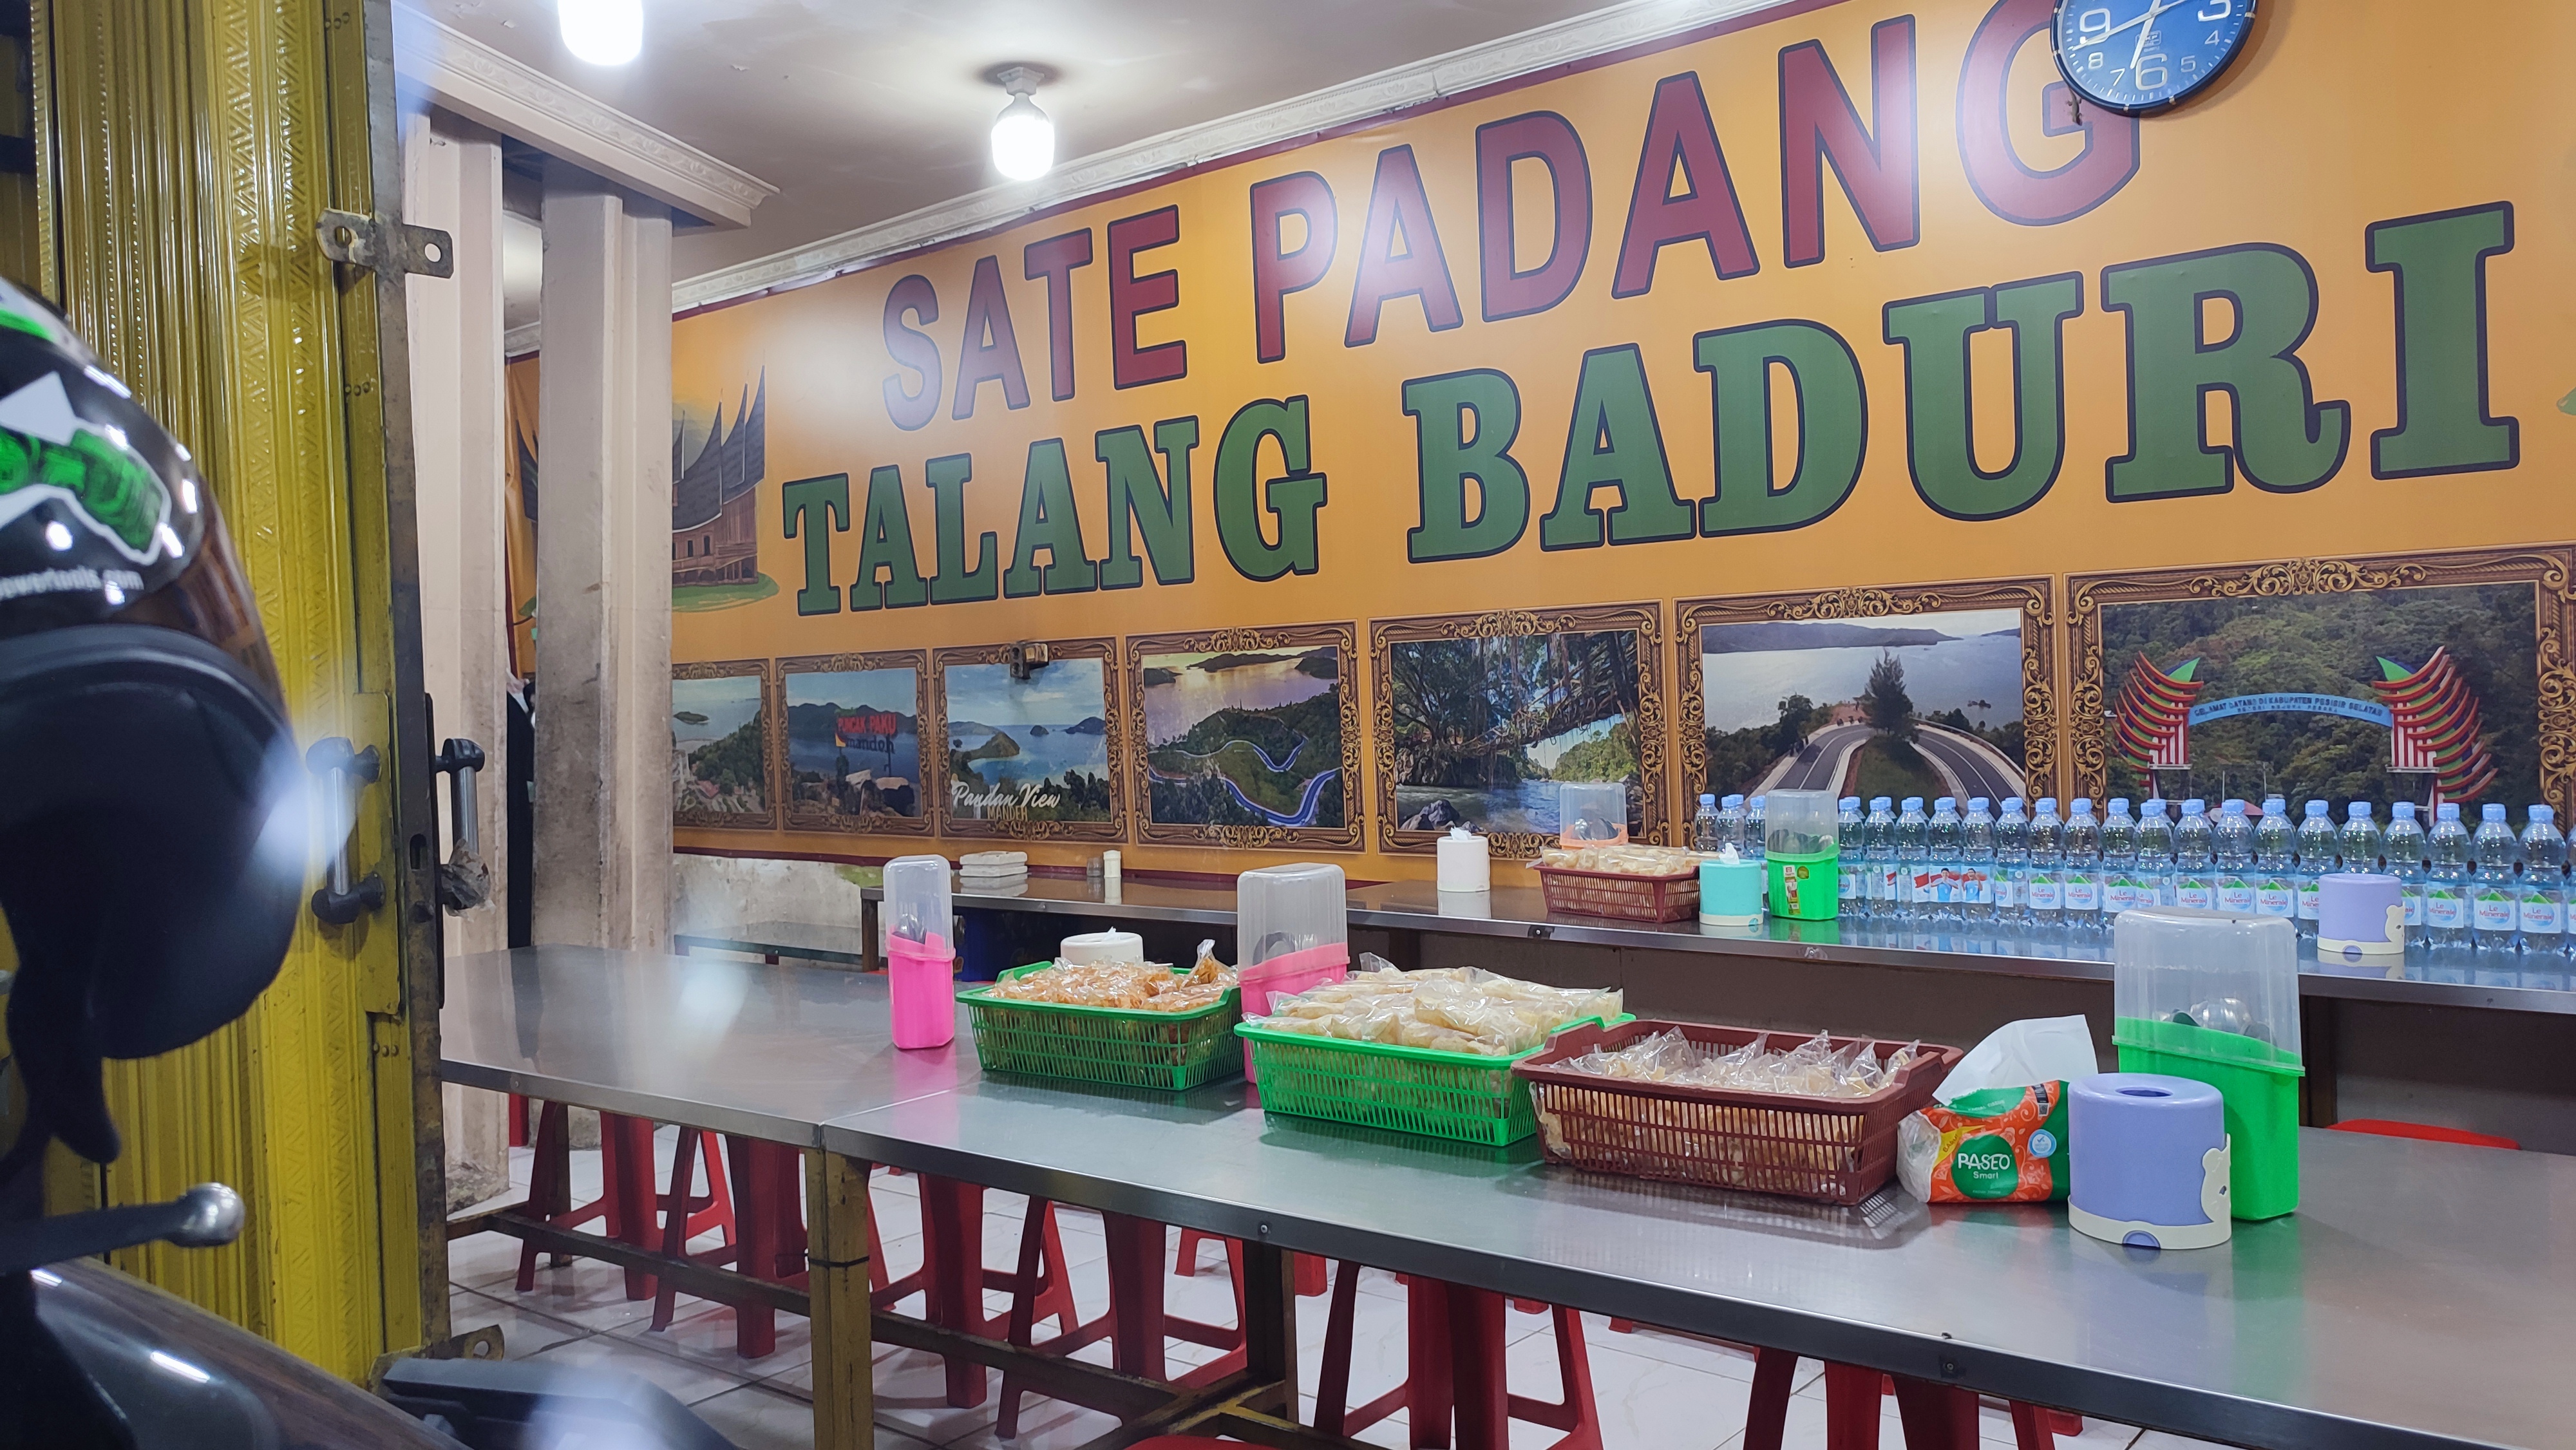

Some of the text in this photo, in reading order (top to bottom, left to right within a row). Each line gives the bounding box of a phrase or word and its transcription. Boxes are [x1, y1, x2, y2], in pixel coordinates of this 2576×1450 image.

[2079, 8, 2110, 43] 9
[2204, 30, 2220, 46] 4
[2088, 52, 2103, 70] 8
[2181, 55, 2196, 73] 5
[2109, 68, 2125, 86] 7
[2136, 53, 2168, 91] 6
[882, 0, 2141, 431] SATE PADANG
[782, 200, 2520, 616] TALANG BADURI
[869, 713, 896, 735] PAKU
[951, 780, 1061, 809] Pandan View
[987, 805, 1028, 822] MANDEH
[2479, 910, 2510, 918] Minerale
[2523, 912, 2554, 921] Minerale
[1958, 1153, 2011, 1170] PASEO
[1973, 1171, 1999, 1180] Smart
